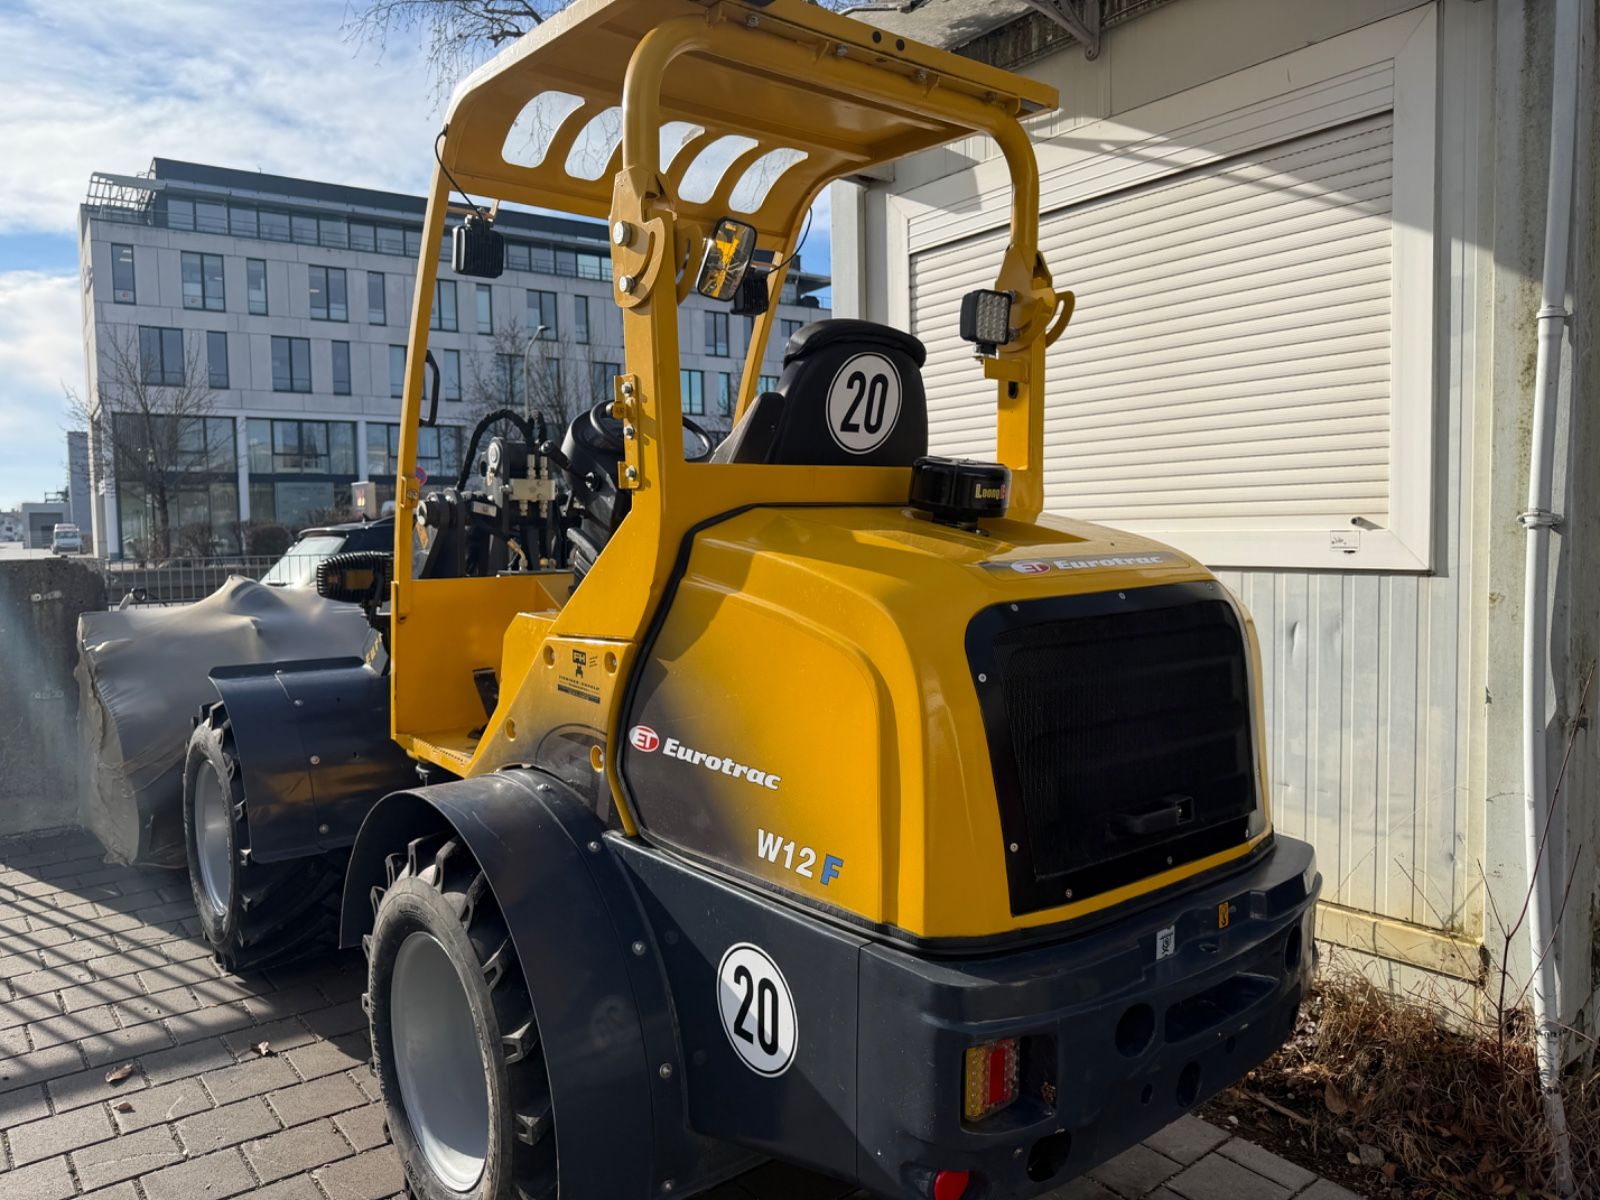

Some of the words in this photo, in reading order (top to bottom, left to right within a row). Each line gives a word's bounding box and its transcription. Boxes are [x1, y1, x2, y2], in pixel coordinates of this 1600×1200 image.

[840, 370, 889, 435] 20
[1053, 555, 1164, 571] Eurotrac
[662, 736, 783, 791] Eurotrac
[757, 827, 817, 880] W12
[819, 853, 845, 887] F
[733, 964, 780, 1057] 20
